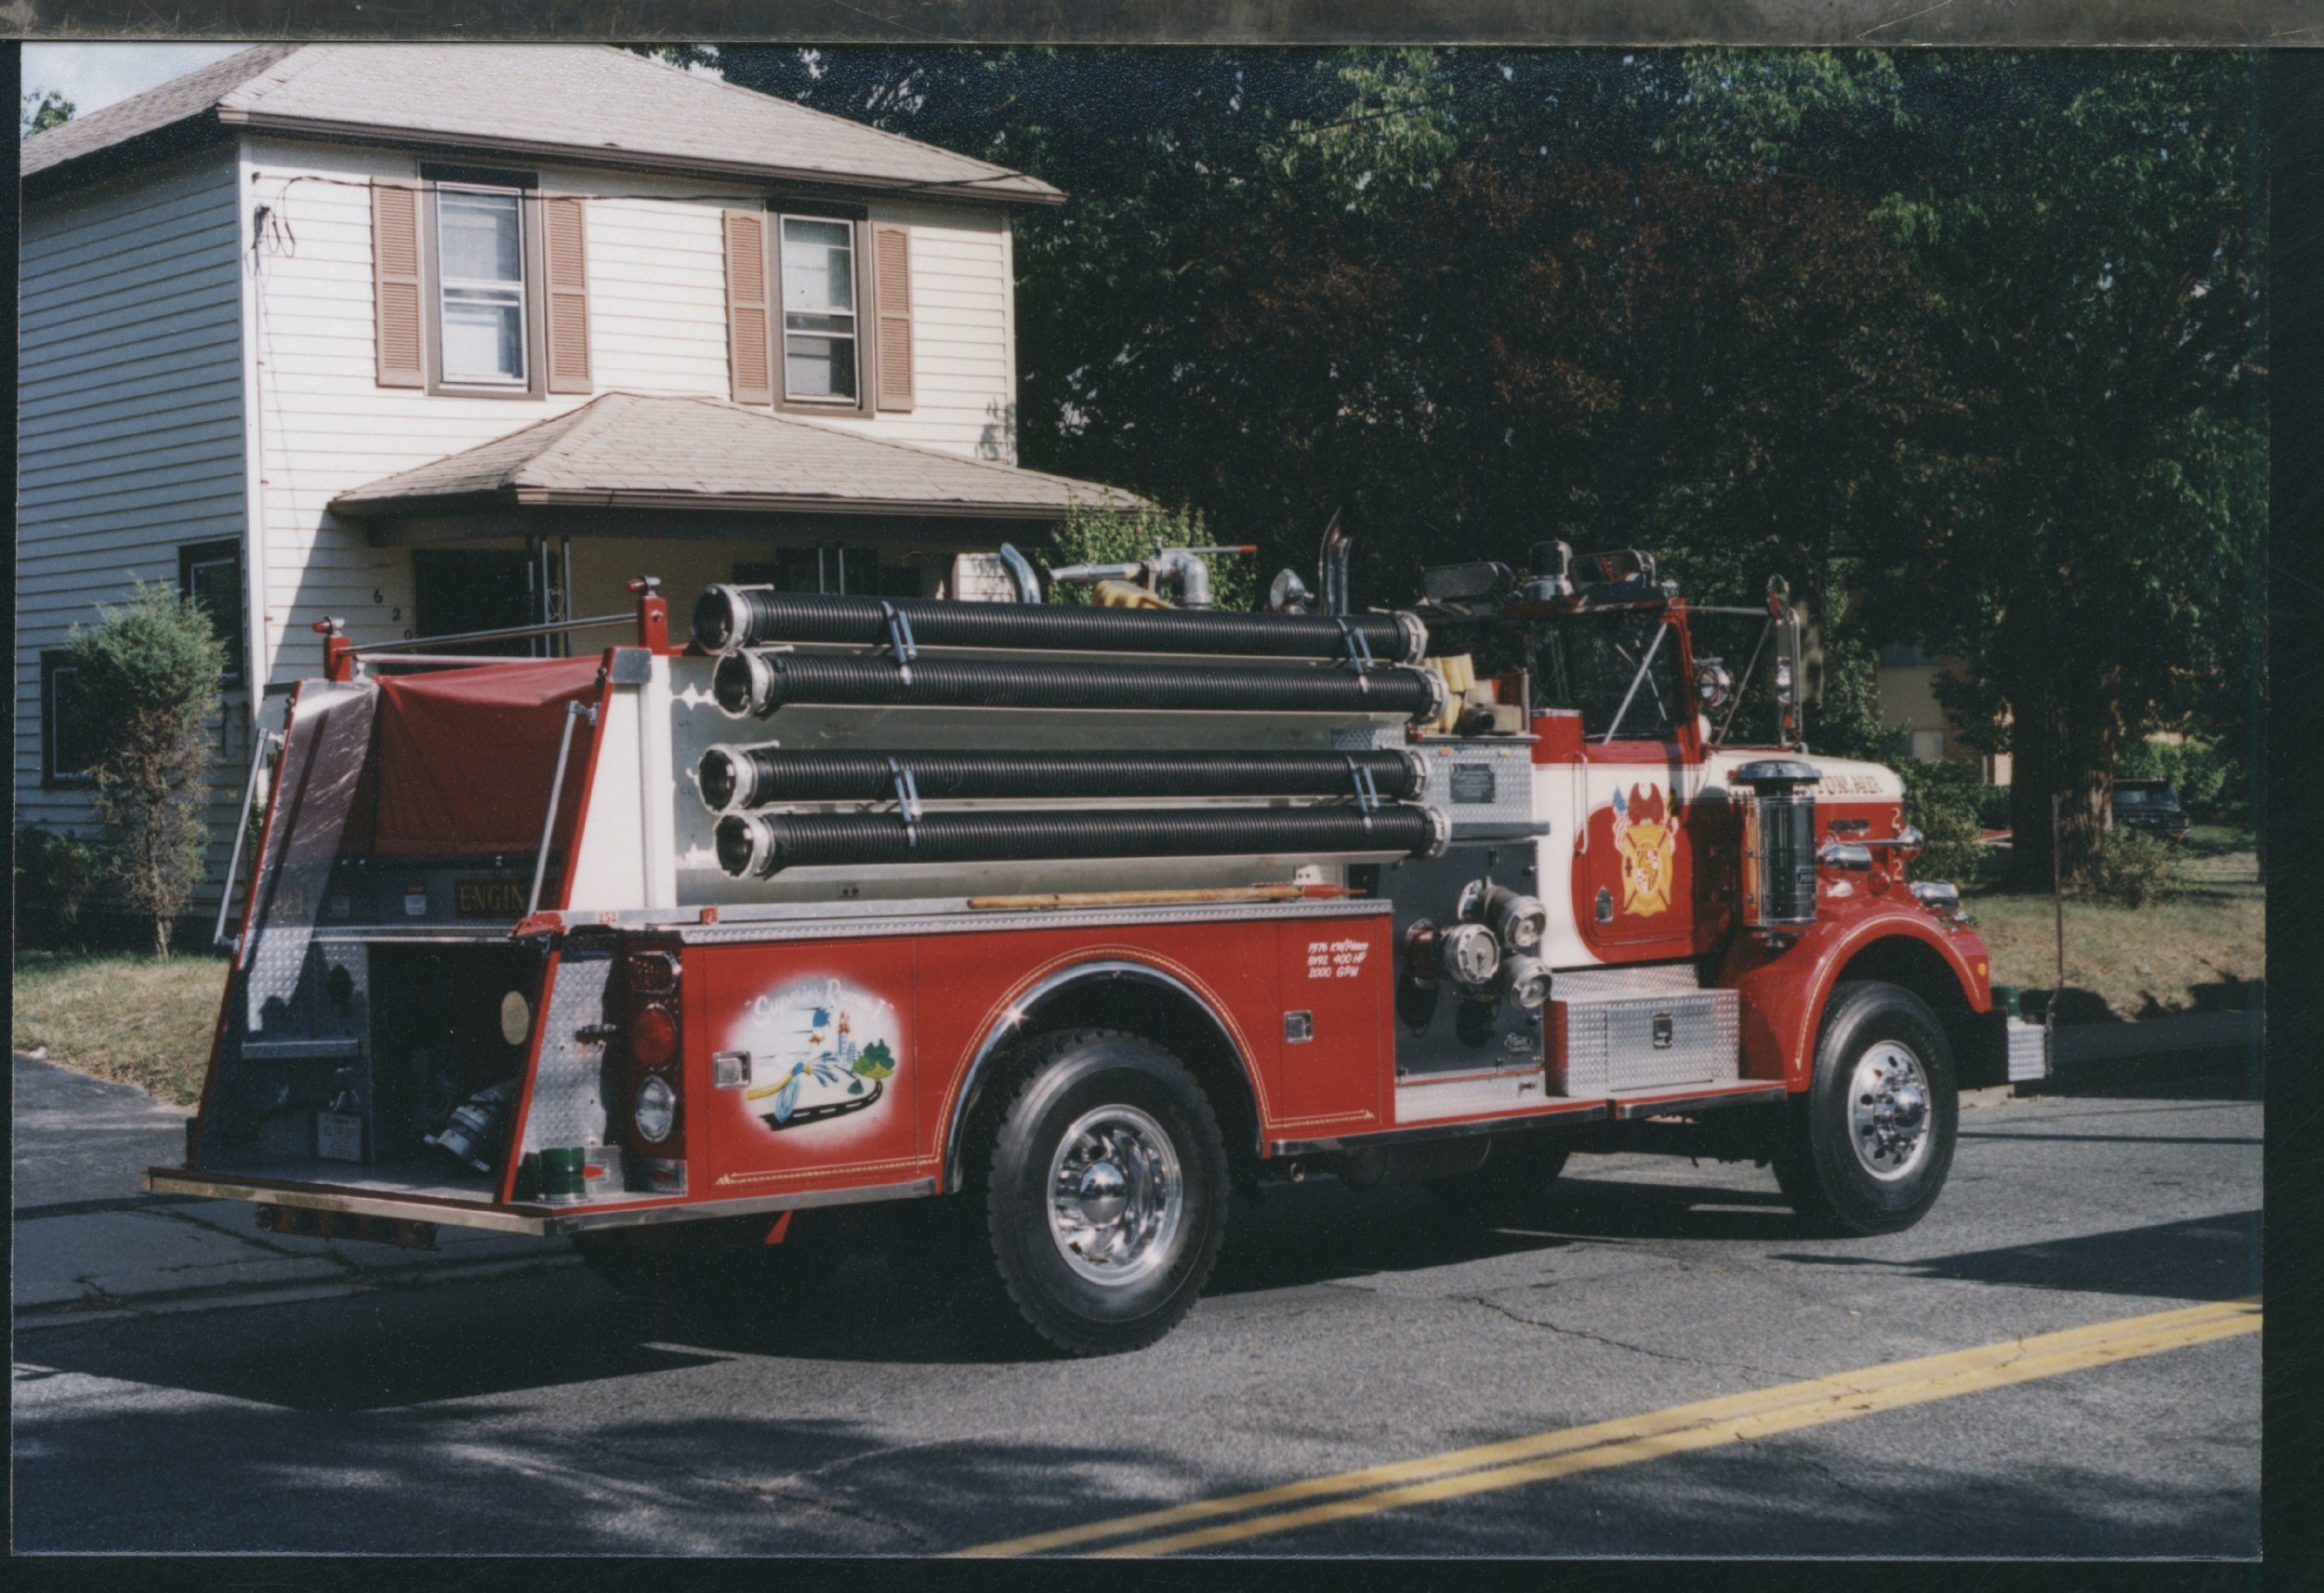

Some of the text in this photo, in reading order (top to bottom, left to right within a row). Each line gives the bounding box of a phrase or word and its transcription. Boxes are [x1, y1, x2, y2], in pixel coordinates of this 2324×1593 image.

[457, 885, 526, 911] ENGIN
[598, 911, 618, 924] 252
[1332, 953, 1353, 965] 400
[1353, 951, 1367, 964] HP
[1308, 967, 1332, 979] 2000
